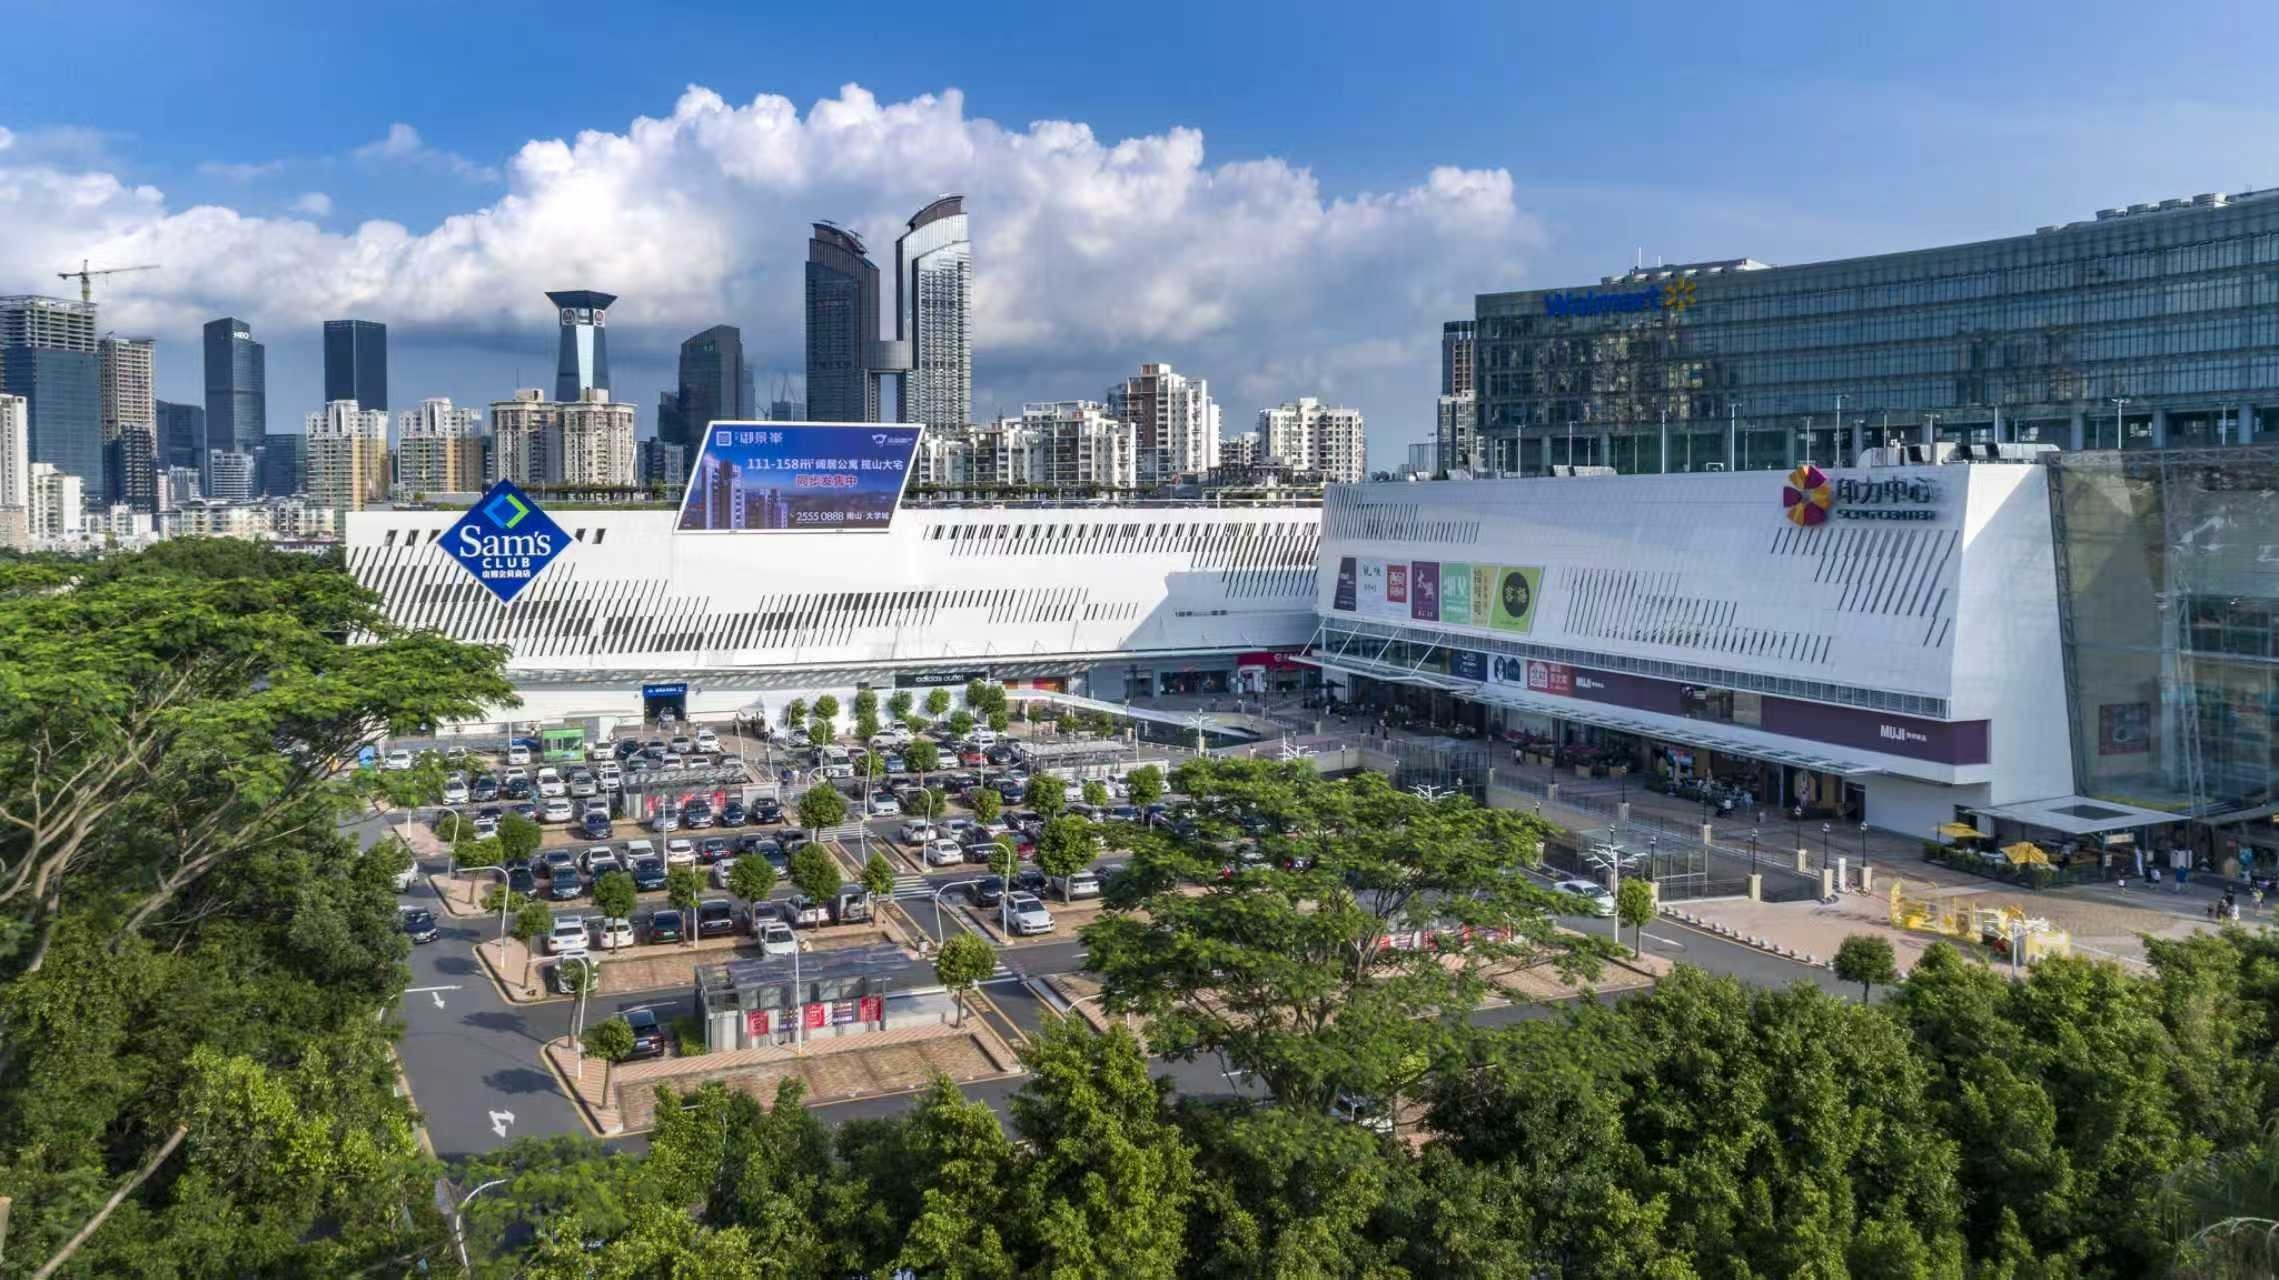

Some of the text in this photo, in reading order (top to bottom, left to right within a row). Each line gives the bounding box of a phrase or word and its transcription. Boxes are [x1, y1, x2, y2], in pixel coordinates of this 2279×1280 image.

[1544, 284, 1662, 317] Walmart
[1836, 475, 1937, 504] 印力中心
[796, 511, 819, 521] 2555
[820, 511, 844, 521] 0888
[459, 525, 552, 558] Sam's
[482, 557, 531, 568] CLUB
[1880, 724, 1905, 741] MUJI
